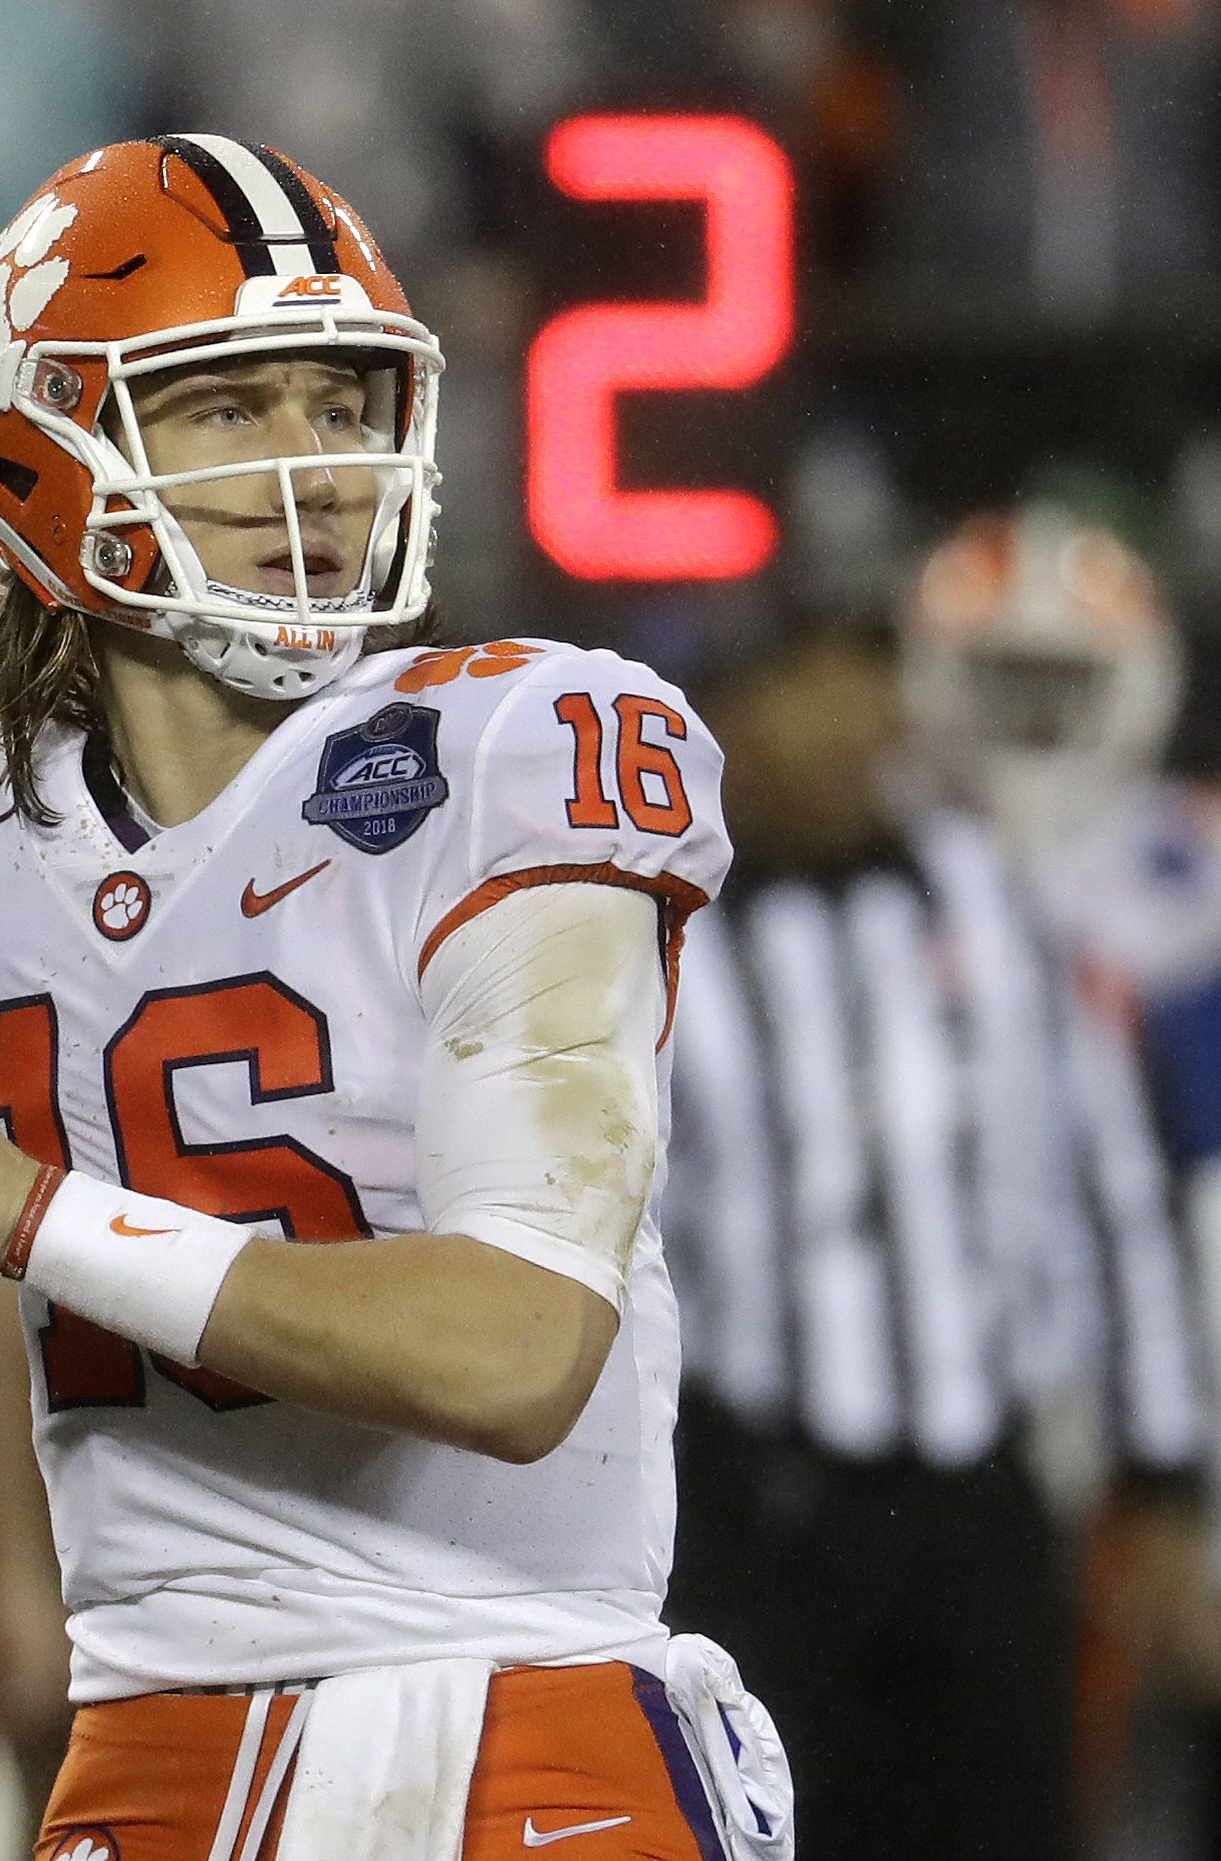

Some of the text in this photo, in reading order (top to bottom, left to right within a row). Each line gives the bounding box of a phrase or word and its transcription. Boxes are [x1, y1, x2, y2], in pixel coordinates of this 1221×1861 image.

[277, 275, 341, 297] ACC
[527, 112, 794, 581] 2
[273, 626, 335, 651] ALL IN
[345, 754, 412, 784] ACC
[553, 692, 693, 838] 16
[318, 781, 436, 815] CHAMPIONSHIP
[363, 818, 396, 836] 2018
